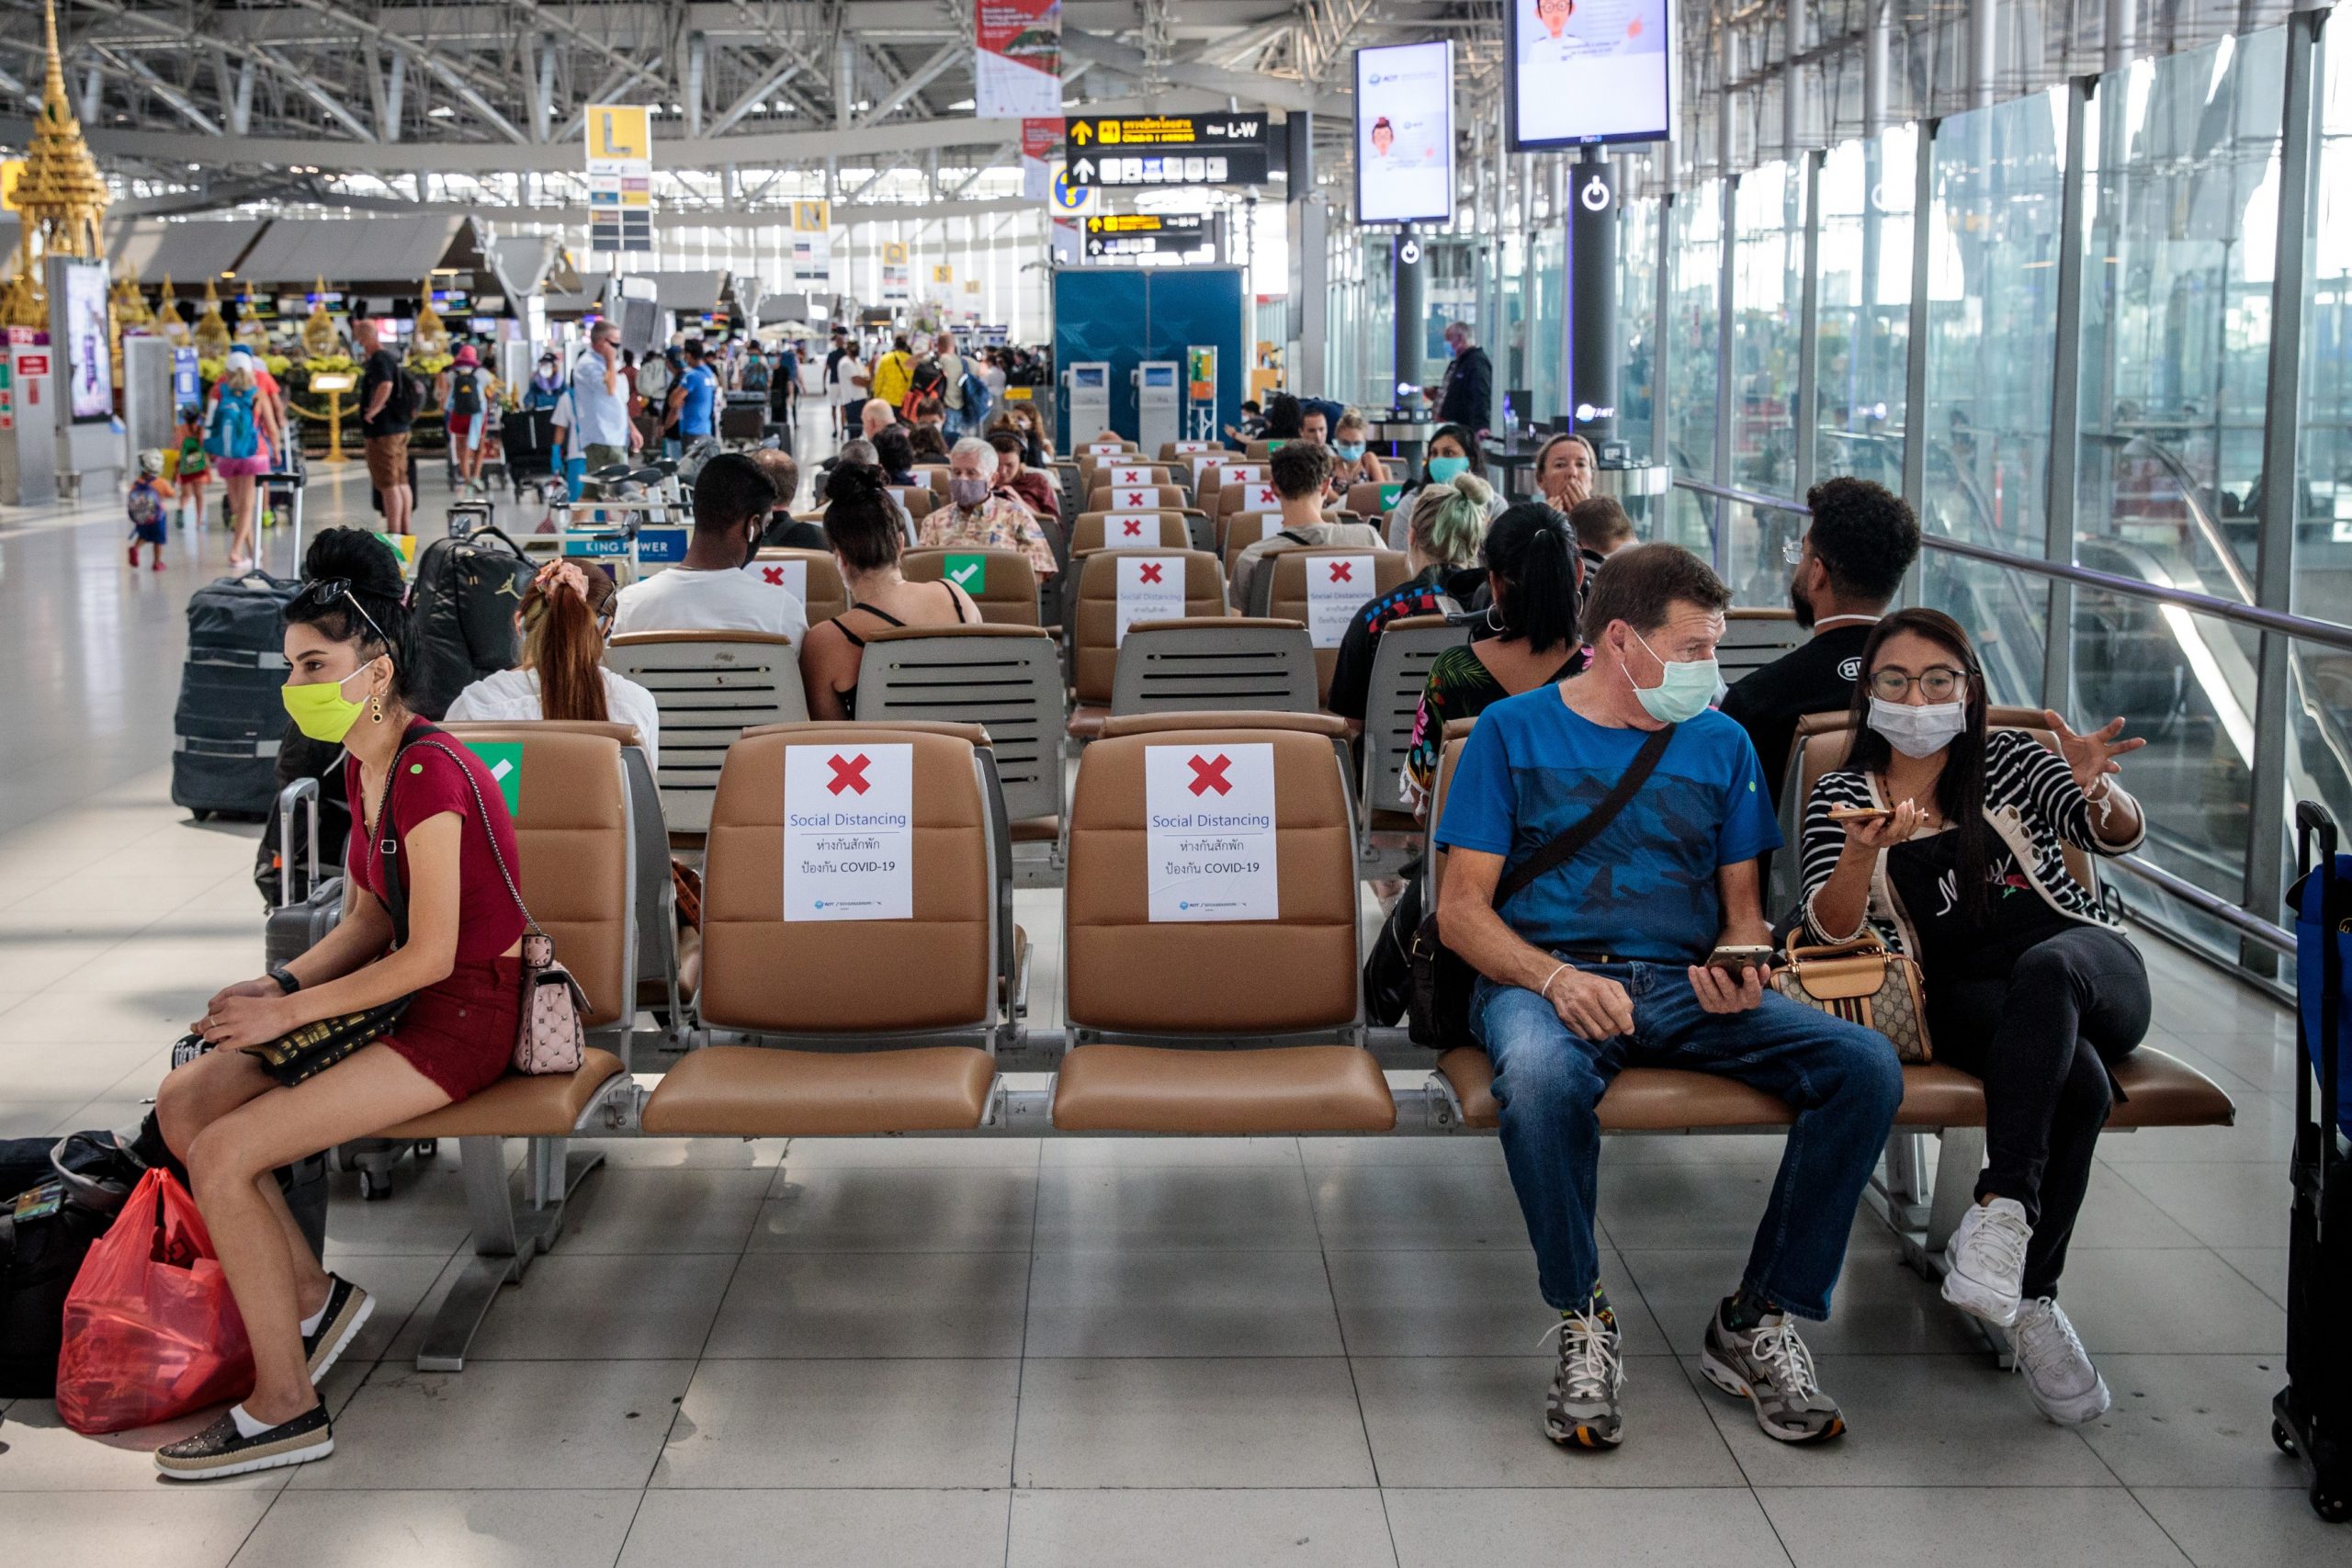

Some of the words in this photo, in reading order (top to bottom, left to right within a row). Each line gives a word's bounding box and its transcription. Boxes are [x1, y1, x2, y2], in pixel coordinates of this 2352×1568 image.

[603, 112, 632, 153] L
[1227, 121, 1259, 139] L-W
[800, 204, 821, 230] N
[585, 542, 619, 552] KING
[623, 542, 668, 553] PWER
[790, 813, 830, 827] Social
[835, 812, 907, 828] Distancing
[1152, 814, 1193, 828] Social
[1197, 813, 1270, 829] Distancing
[817, 837, 880, 851] ห่างกันสักพัก
[1180, 839, 1244, 852] ห่างกันสักพัก
[801, 860, 837, 874] ป้องกัน
[841, 861, 896, 873] COVID-19
[1165, 861, 1201, 874] ป้องกัน
[1204, 863, 1260, 874] COVID-19
